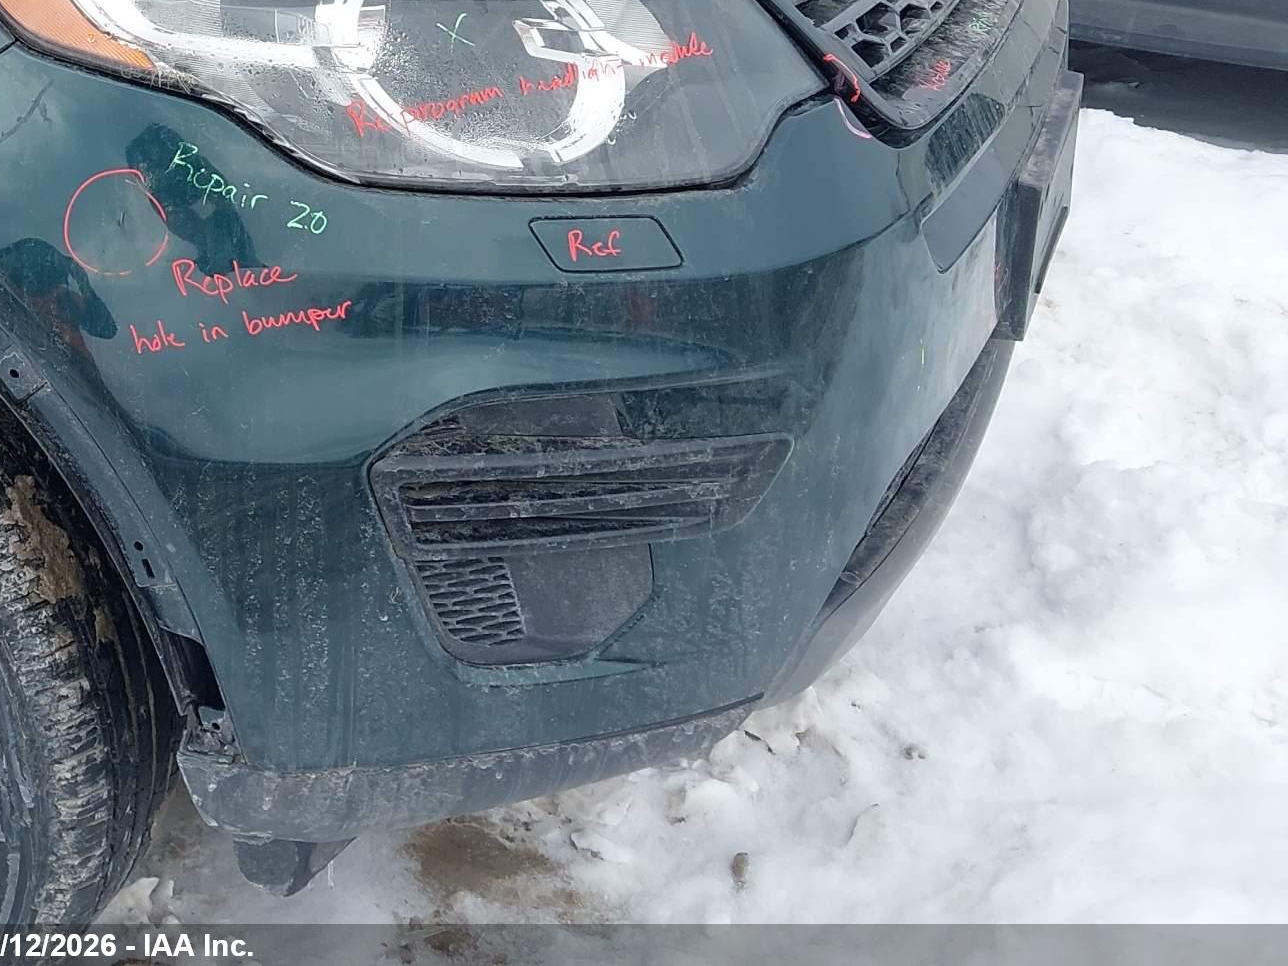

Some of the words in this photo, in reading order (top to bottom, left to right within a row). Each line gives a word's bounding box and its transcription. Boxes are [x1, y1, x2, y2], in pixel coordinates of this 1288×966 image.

[568, 229, 623, 263] Ref
[171, 259, 299, 305] Replace
[129, 320, 186, 355] hole
[199, 321, 229, 344] in
[242, 299, 352, 332] bumper
